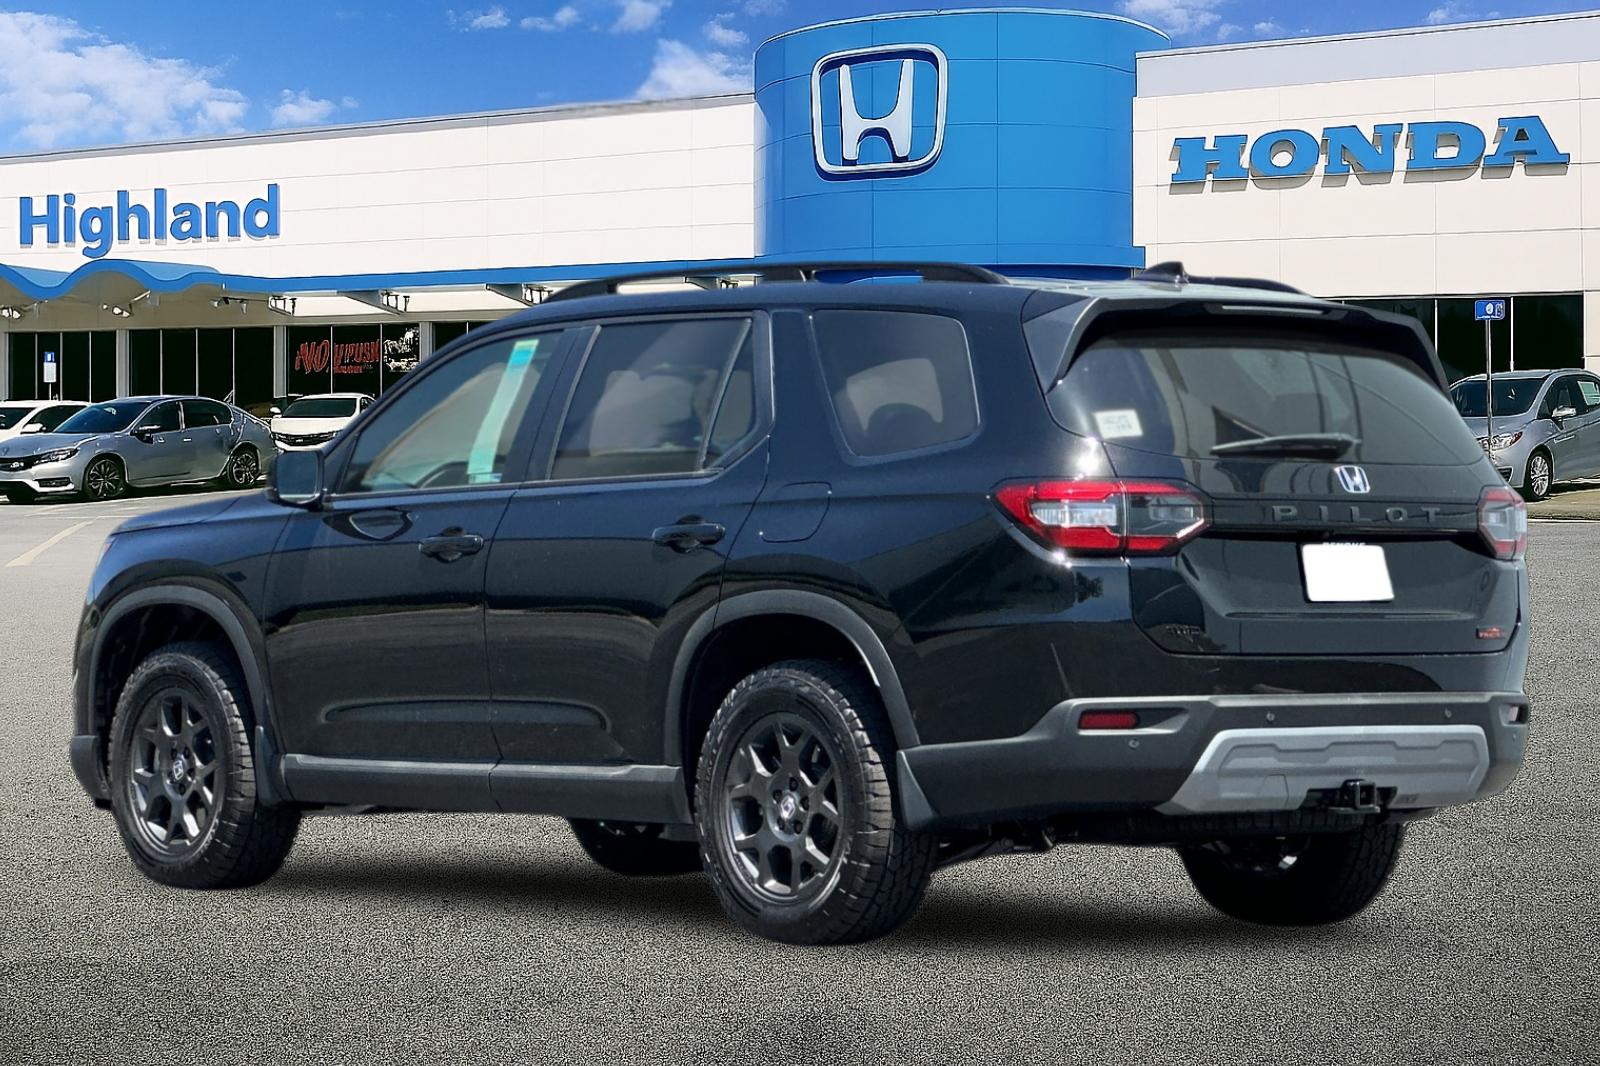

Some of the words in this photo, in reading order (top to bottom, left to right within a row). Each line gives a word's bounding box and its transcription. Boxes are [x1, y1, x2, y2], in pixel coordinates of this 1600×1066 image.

[1170, 115, 1571, 186] HONDA
[19, 184, 281, 258] Highland
[1271, 505, 1441, 523] PILOT
